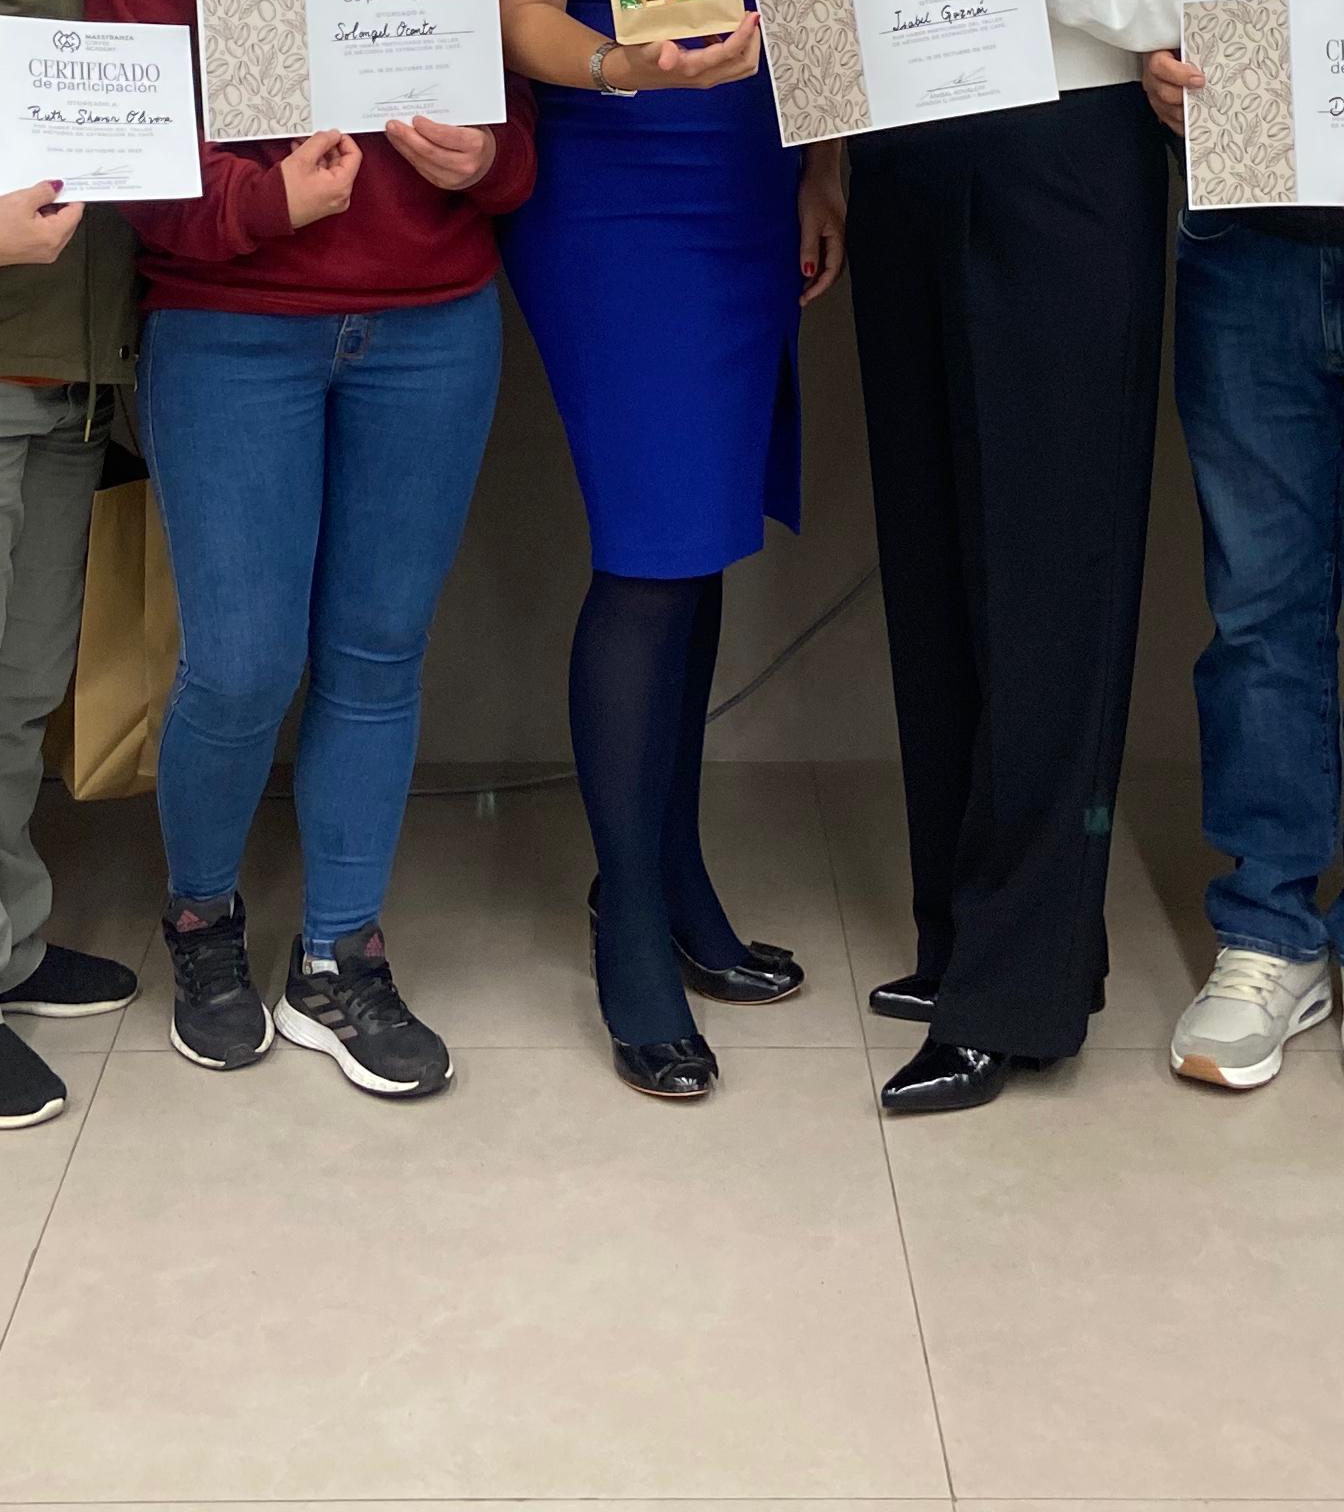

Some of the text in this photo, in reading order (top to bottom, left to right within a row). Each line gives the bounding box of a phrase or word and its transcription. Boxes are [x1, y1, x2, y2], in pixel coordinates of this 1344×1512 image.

[892, 10, 932, 32] Isabel
[28, 58, 160, 82] CERTIFICADO
[33, 77, 157, 94] de participación
[27, 105, 67, 122] Ruth
